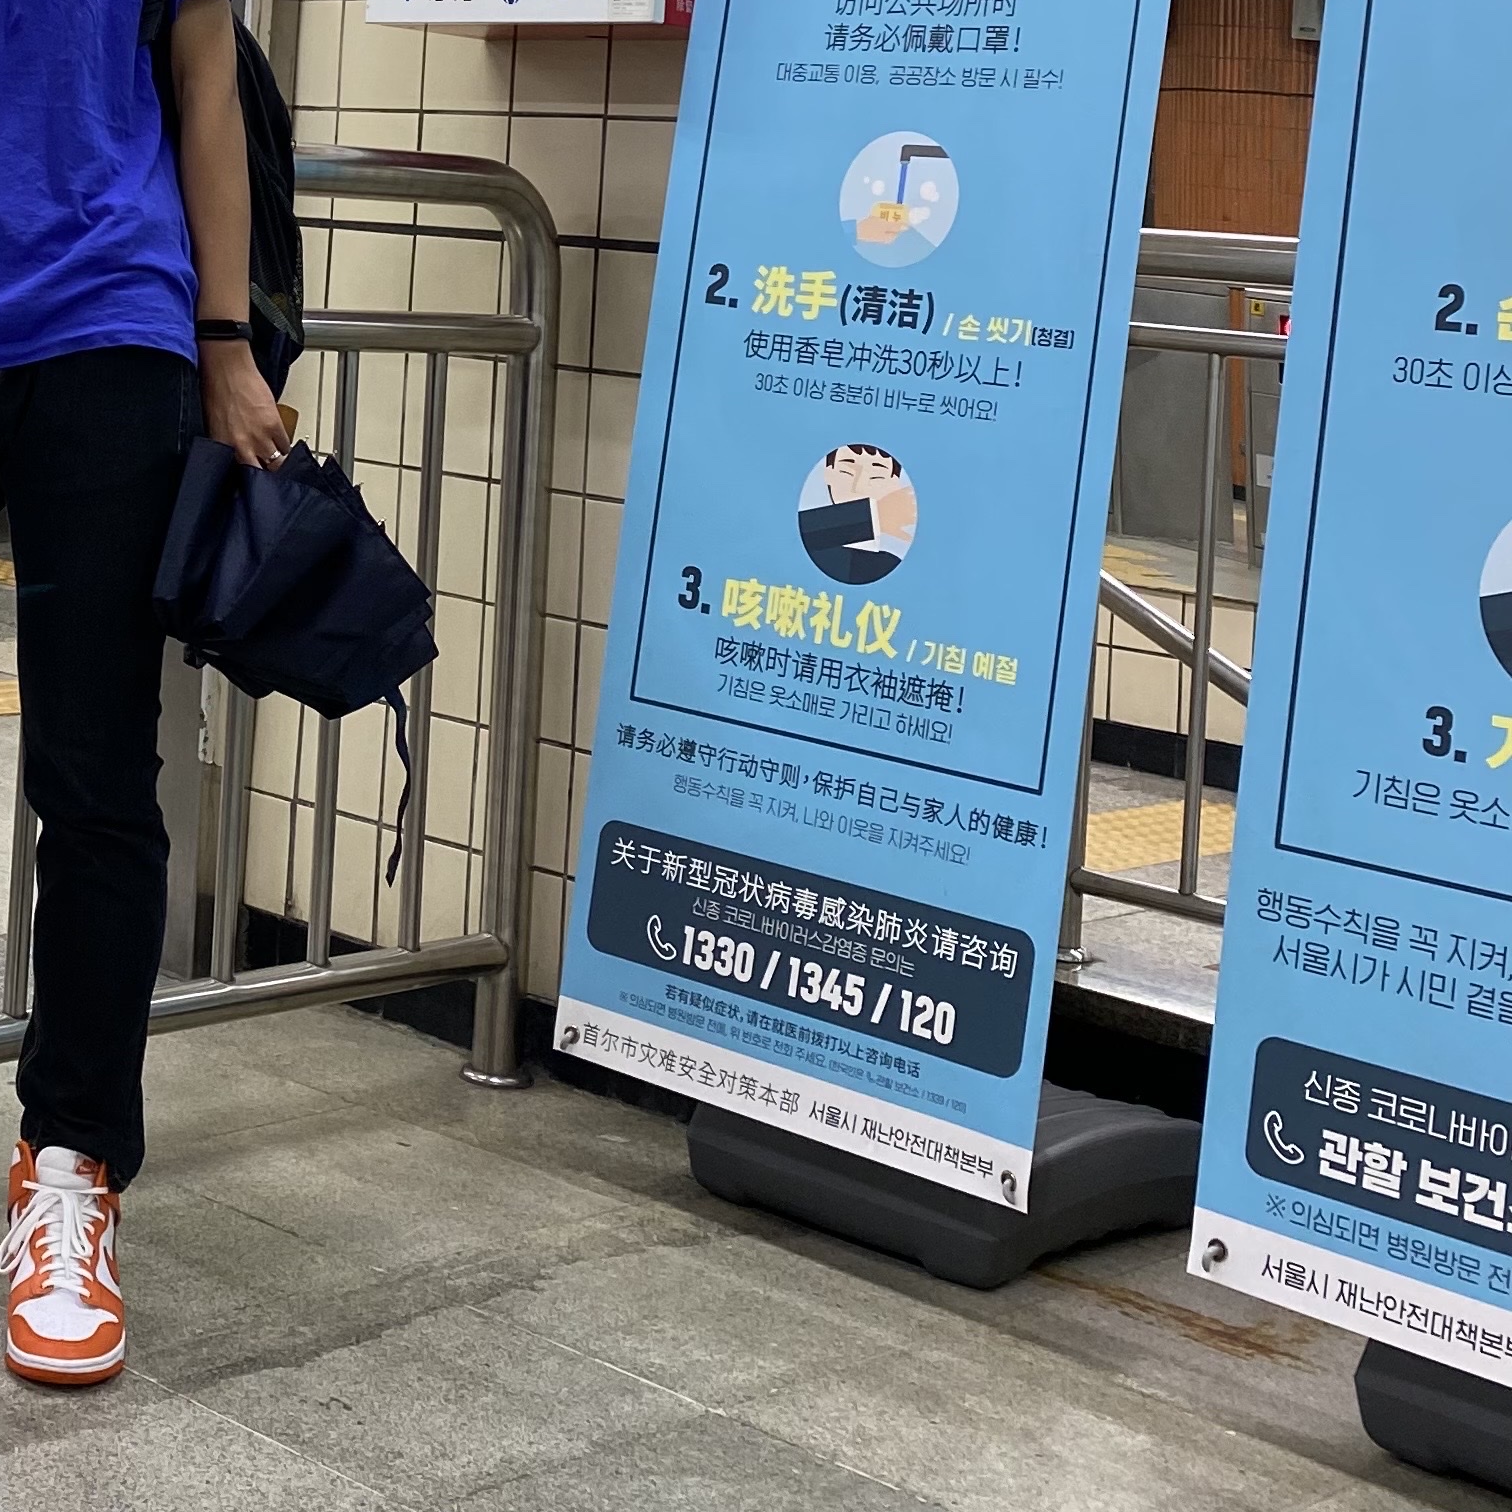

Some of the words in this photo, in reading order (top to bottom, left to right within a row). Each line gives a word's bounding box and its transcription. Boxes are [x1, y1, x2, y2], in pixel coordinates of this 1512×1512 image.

[824, 23, 1021, 54] 请务必佩戴口罩!
[776, 62, 841, 84] 대중교통
[844, 65, 880, 86] 이용,
[888, 66, 956, 87] 공공장소
[961, 67, 996, 88] 방문
[999, 68, 1019, 89] 시
[1023, 69, 1064, 90] 필수!
[705, 262, 738, 309] 2.
[957, 317, 981, 341] 손
[1435, 284, 1478, 335] 2.
[754, 372, 788, 395] 30초
[793, 377, 826, 400] 이상
[829, 381, 879, 408] 충분히
[884, 388, 935, 415] 비누로
[940, 396, 998, 423] 씻어요!
[1393, 356, 1453, 389] 30초
[678, 565, 710, 615] 3.
[721, 577, 902, 659] 咳嗽礼仪
[923, 640, 967, 675] 기침
[972, 650, 1020, 686] 예절
[717, 673, 765, 704] 기침은
[769, 685, 836, 719] 옷소매로
[839, 699, 891, 731] 가리고
[896, 713, 953, 746] 하세요!
[1422, 705, 1467, 763] 3.
[673, 773, 744, 809] 행동수칙을
[748, 792, 763, 813] 꼭
[766, 796, 799, 824] 지켜,
[803, 806, 834, 831] 나와
[838, 814, 884, 845] 이웃을
[888, 828, 971, 866] 지켜주세요!
[1352, 769, 1440, 816] 기침은
[610, 836, 1018, 979] 关于新型冠状病毒感染肺炎请咨询
[692, 896, 721, 920] 신종
[722, 905, 867, 964] 코로나바이러스감염증
[870, 947, 916, 978] 문의는
[1257, 887, 1401, 951] 행동수칙을
[1409, 923, 1439, 961] 꼭
[681, 925, 756, 984] 1330
[788, 956, 865, 1017] 1345
[900, 990, 956, 1046] 120
[1273, 934, 1390, 992] 서울시가
[1396, 965, 1456, 1010] 시민
[583, 1022, 801, 1116] 首尔市灾难安全对策本部
[808, 1099, 857, 1134] 서울시
[860, 1116, 994, 1178] 재난안전대책본부
[1304, 1070, 1362, 1115] 신종
[1319, 1128, 1408, 1199] 관할
[1415, 1159, 1512, 1233] 보건
[1261, 1254, 1329, 1299] 서울시
[1289, 1200, 1379, 1251] 의심되면
[1387, 1231, 1481, 1285] 병원방문
